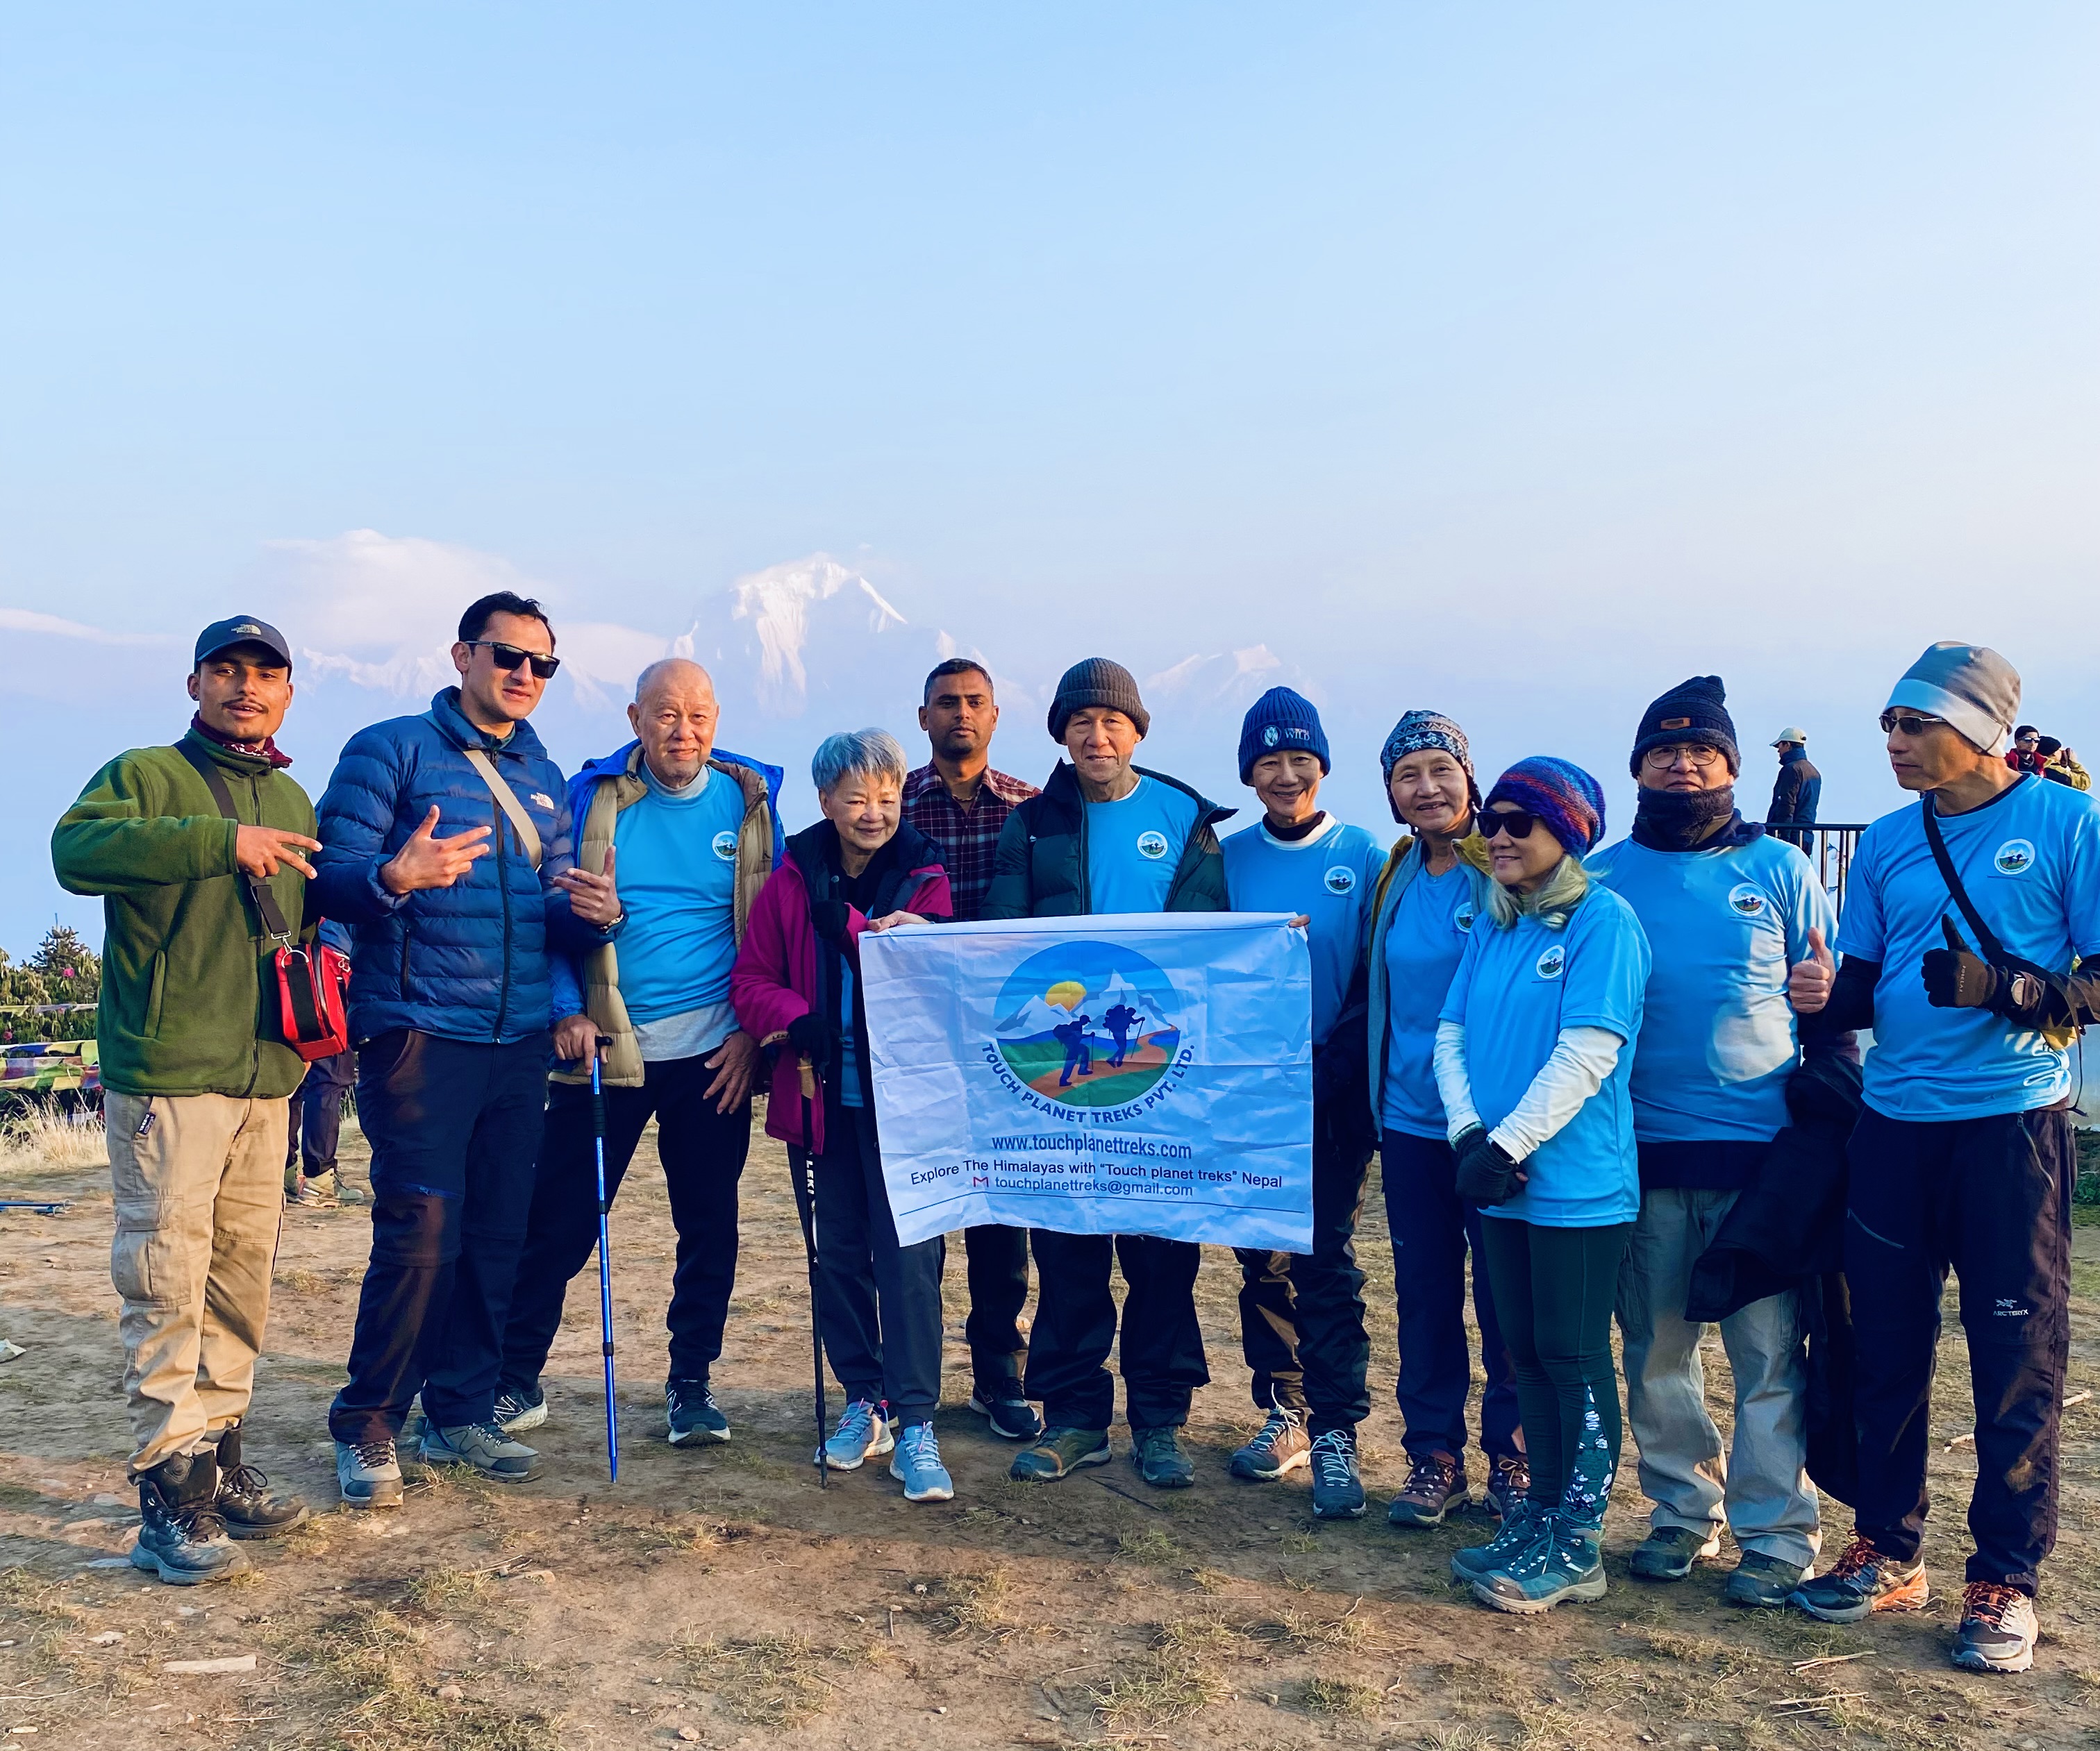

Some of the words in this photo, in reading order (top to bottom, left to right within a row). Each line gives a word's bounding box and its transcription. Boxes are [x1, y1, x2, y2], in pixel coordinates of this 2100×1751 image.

[982, 1043, 1022, 1094] TOUCH
[1021, 1091, 1087, 1123] PLANET
[1091, 1104, 1143, 1123] TREKS
[1144, 1080, 1177, 1109] PVT.
[1171, 1044, 1195, 1079] LTD.
[992, 1132, 1192, 1159] www.touchplanettreks.com
[806, 1159, 815, 1195] LEKI
[910, 1165, 960, 1185] Explore
[962, 1159, 989, 1172] The
[993, 1159, 1065, 1175] Himalayas
[1069, 1162, 1096, 1174] with
[1099, 1163, 1147, 1177] “Touch
[1151, 1166, 1194, 1180] planet
[1197, 1169, 1238, 1182] treks”
[1242, 1171, 1283, 1189] Nepal
[995, 1176, 1193, 1196] touchplanettreks@gmail.com
